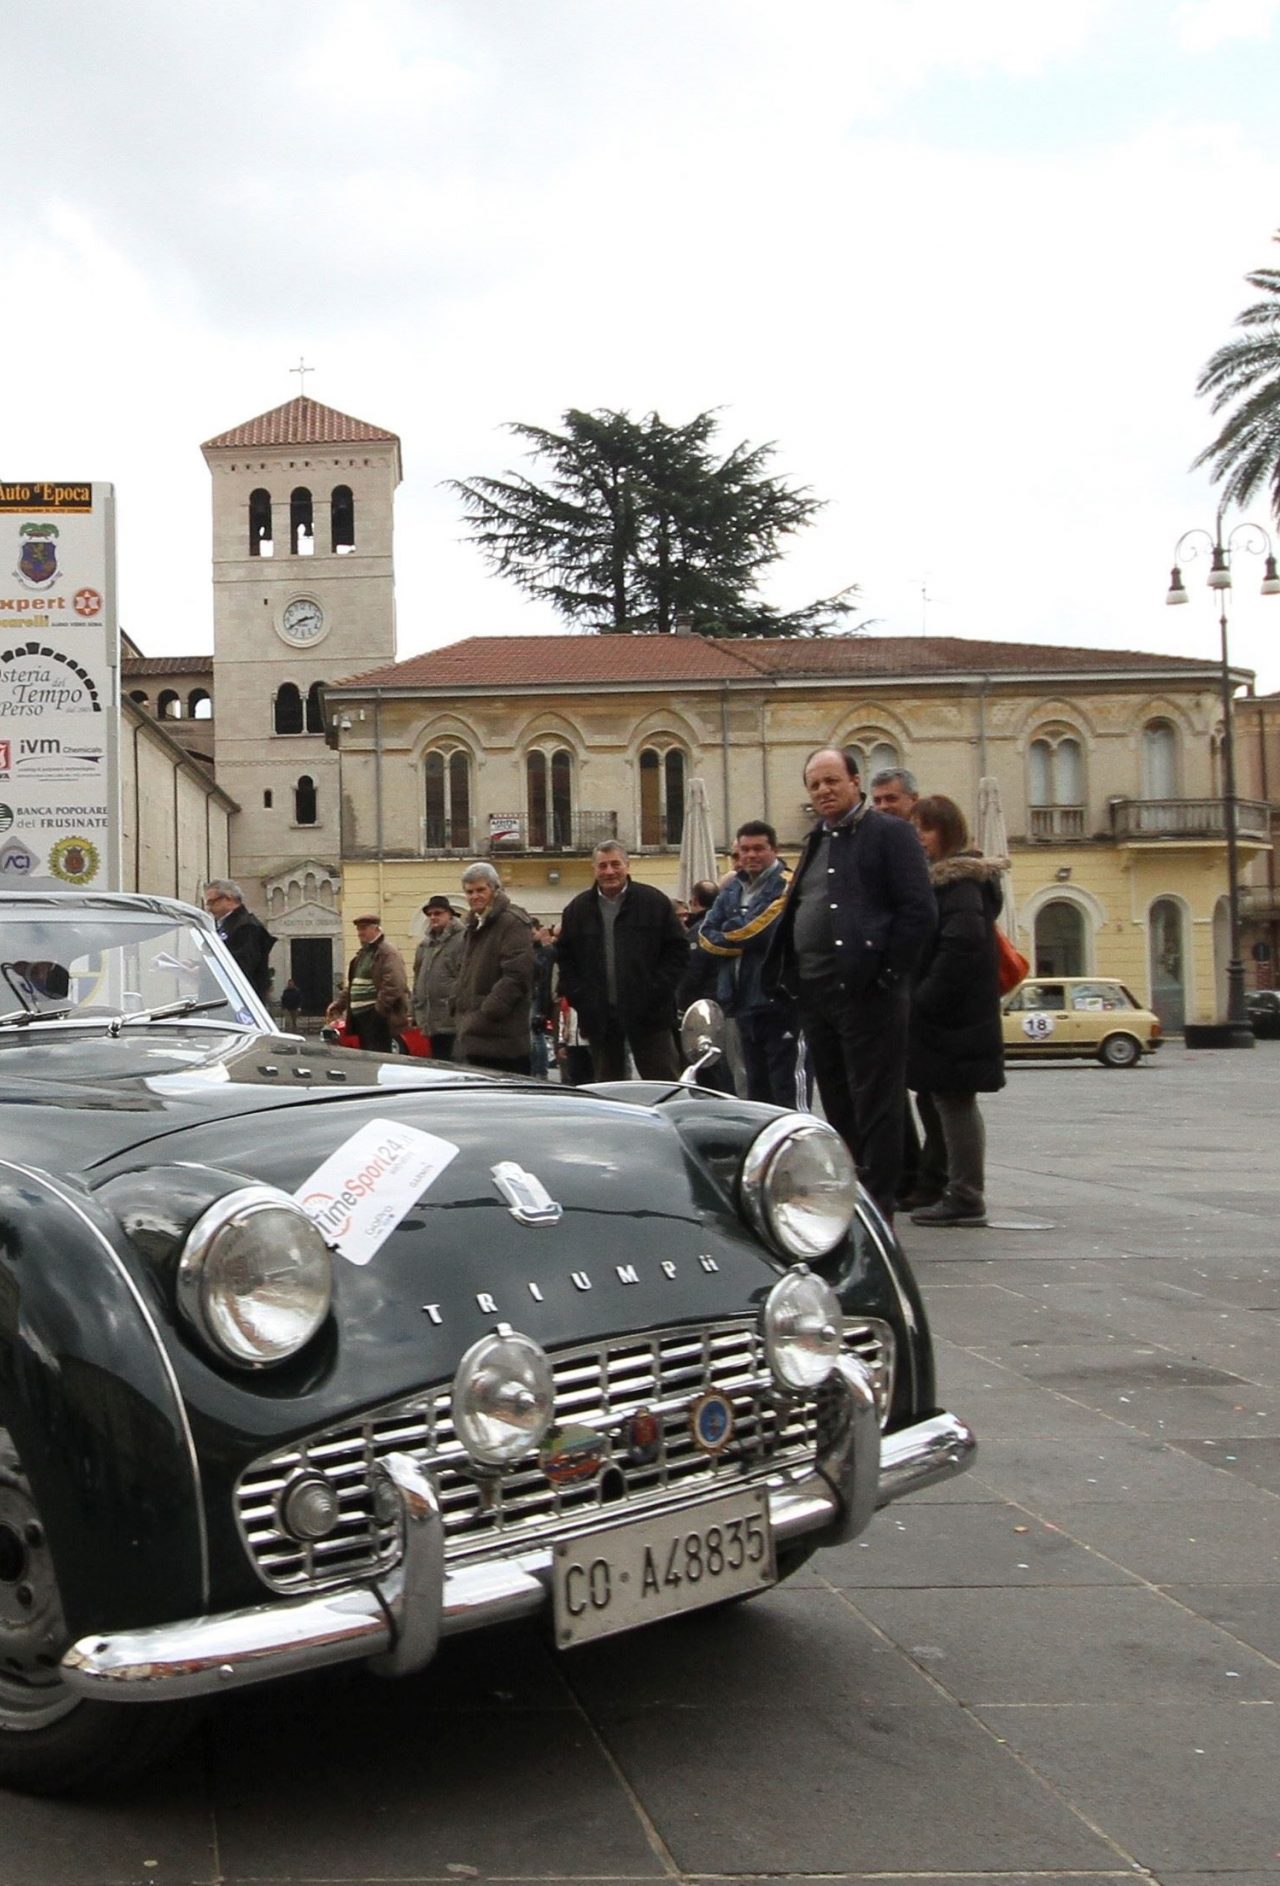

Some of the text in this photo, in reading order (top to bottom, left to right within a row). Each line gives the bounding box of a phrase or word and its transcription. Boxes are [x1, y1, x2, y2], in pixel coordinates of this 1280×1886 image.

[12, 682, 83, 710] Tempo
[16, 806, 109, 816] BANCA POPOLARE
[40, 818, 109, 828] FRUSINATE
[5, 855, 30, 869] ACI
[1026, 1018, 1048, 1032] 18
[422, 1253, 721, 1326] TRIUMPH
[564, 1513, 765, 1617] CO A48835
